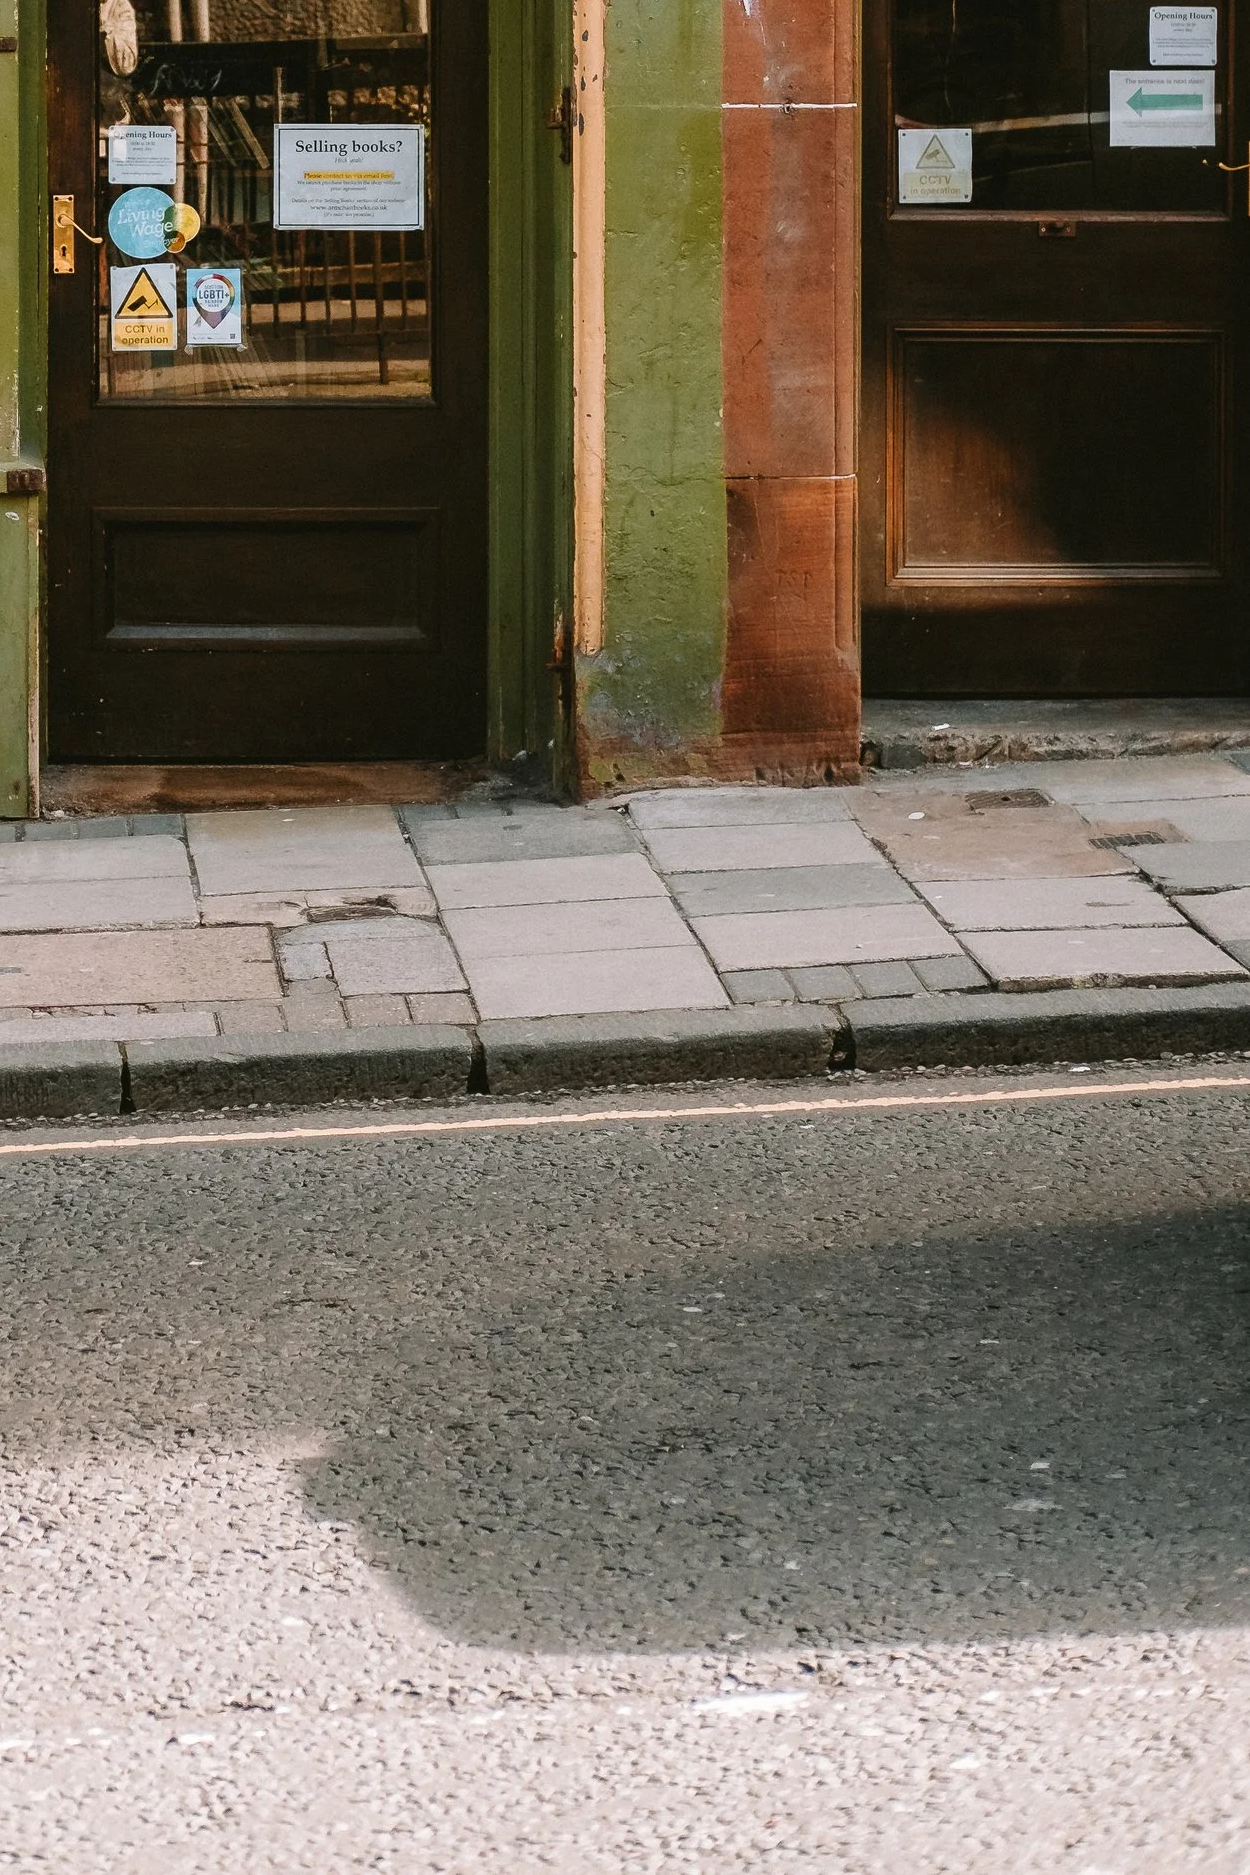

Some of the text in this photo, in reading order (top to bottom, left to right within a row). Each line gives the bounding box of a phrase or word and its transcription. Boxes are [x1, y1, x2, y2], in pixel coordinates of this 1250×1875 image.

[1154, 12, 1213, 21] Opening Hours
[149, 131, 172, 139] Hours
[295, 140, 403, 156] Selling books?
[919, 175, 952, 185] CCTV
[920, 187, 961, 197] operation
[118, 206, 166, 224] Living
[132, 221, 174, 238] Wage
[198, 289, 230, 300] LGBTI+
[125, 324, 165, 334] CCTV in
[121, 335, 169, 346] operation
